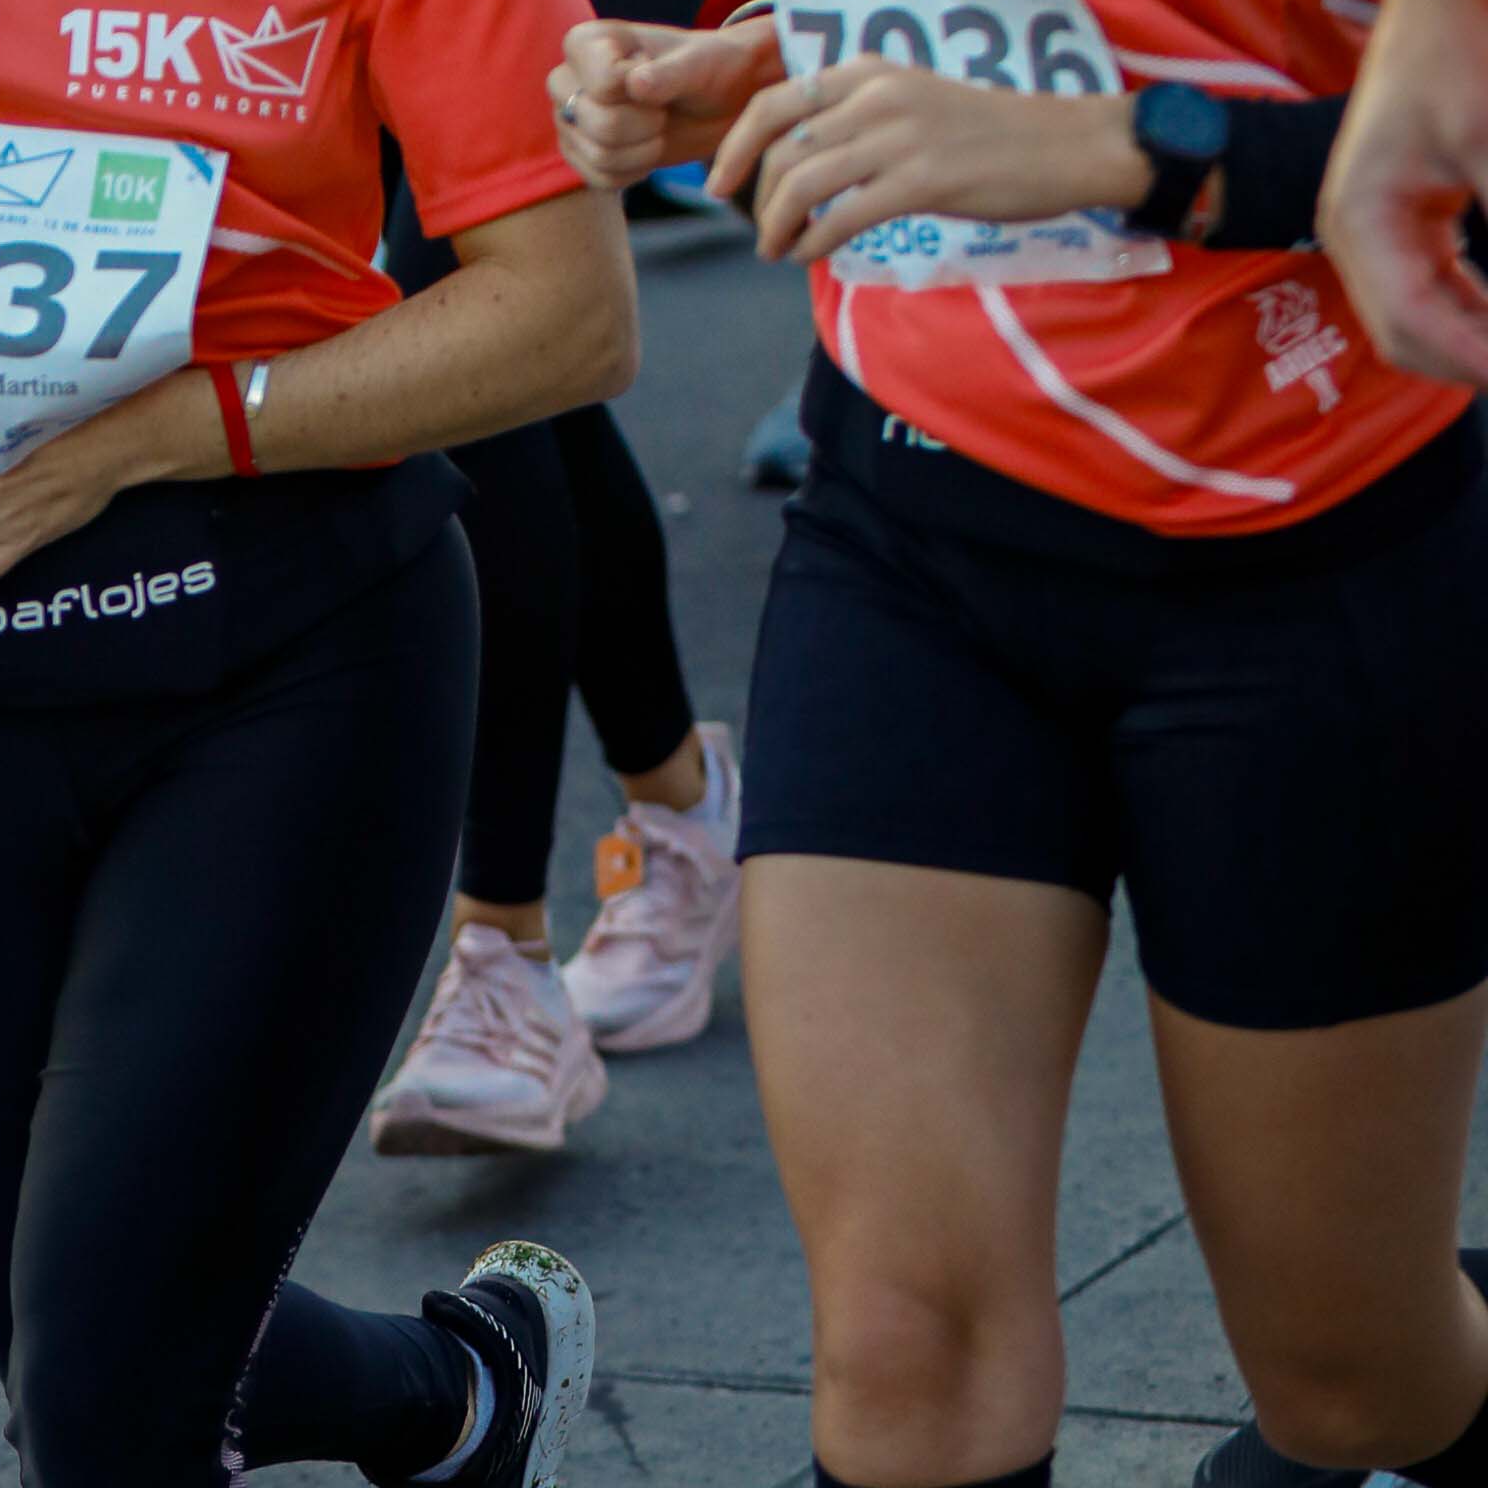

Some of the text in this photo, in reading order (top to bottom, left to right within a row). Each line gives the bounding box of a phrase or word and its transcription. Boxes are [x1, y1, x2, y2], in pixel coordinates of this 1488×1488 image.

[59, 8, 205, 84] 15K
[789, 6, 1104, 95] 7036
[66, 82, 308, 124] PUERTO NORTE
[99, 172, 160, 202] 10K
